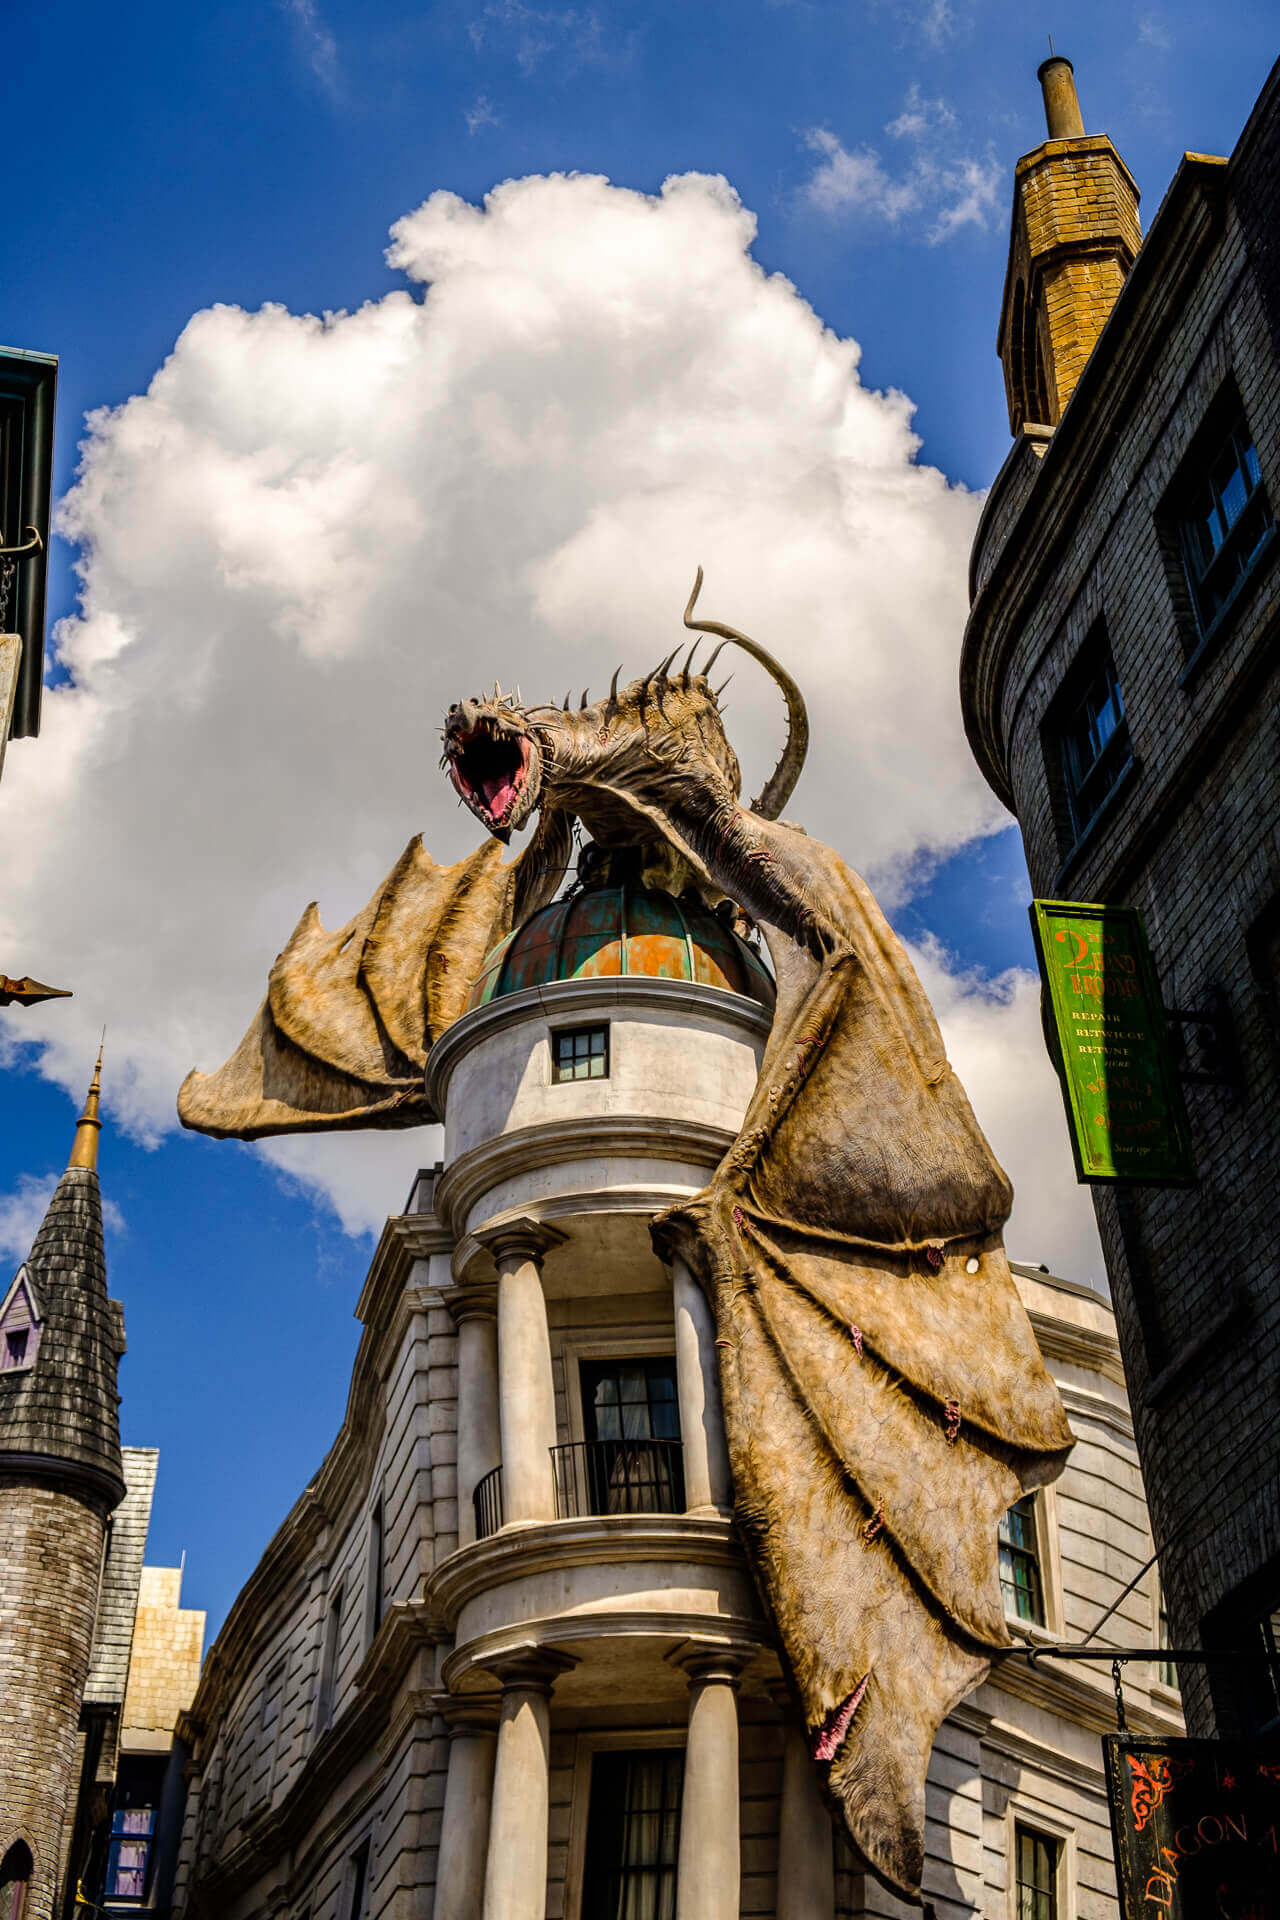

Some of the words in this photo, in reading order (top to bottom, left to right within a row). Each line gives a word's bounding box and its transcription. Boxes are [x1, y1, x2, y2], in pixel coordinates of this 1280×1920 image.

[1070, 974, 1140, 1001] BROOMS
[1072, 1011, 1121, 1022] REPAIR
[1079, 1045, 1129, 1056] RETUNE
